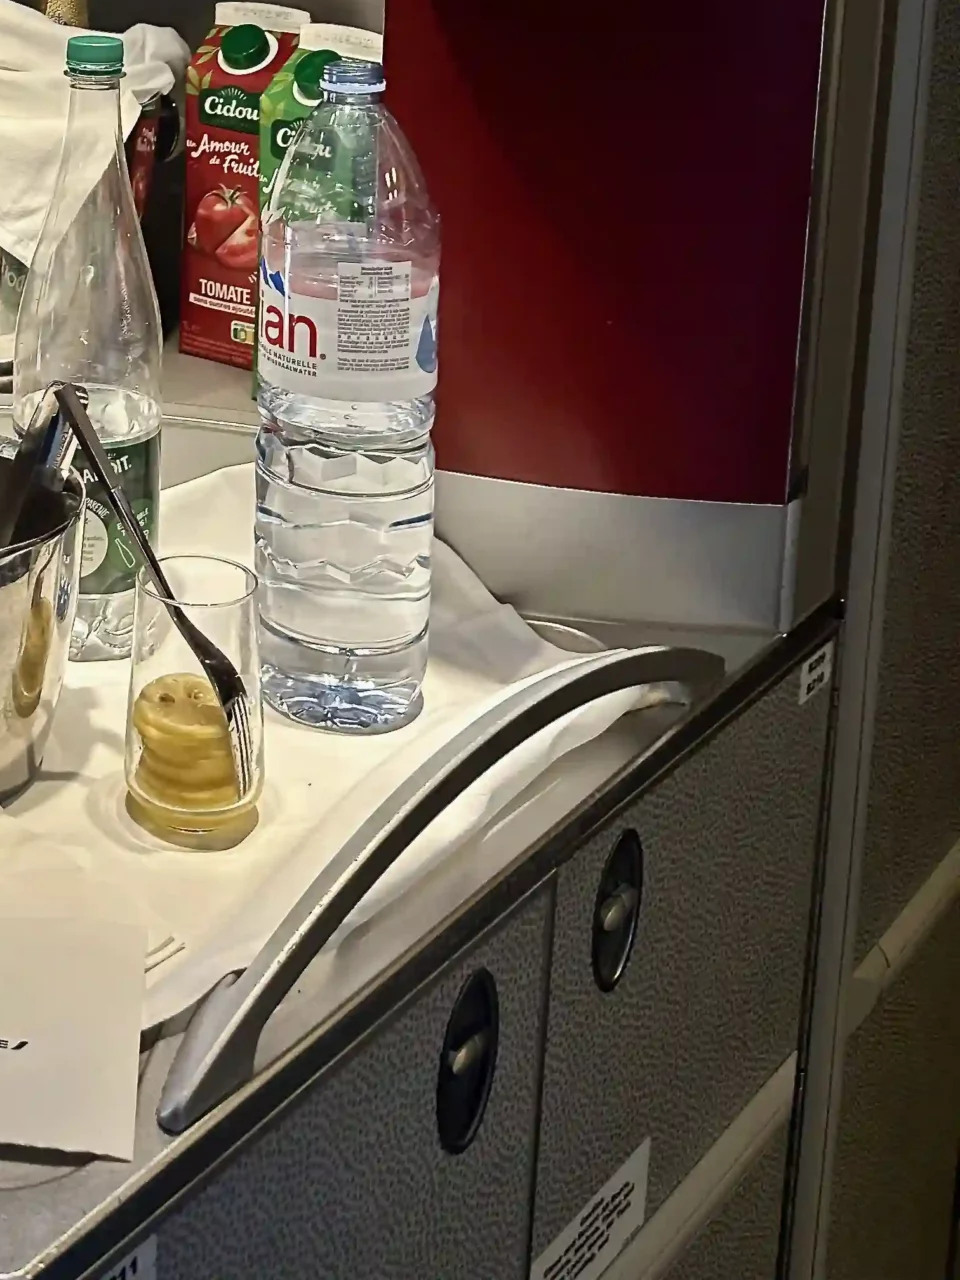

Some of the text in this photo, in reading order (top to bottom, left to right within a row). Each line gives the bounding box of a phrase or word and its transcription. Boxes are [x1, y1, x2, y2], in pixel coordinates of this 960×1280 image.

[203, 95, 261, 121] Cidou
[190, 133, 251, 158] Amour
[209, 154, 261, 178] de Fruit
[199, 278, 252, 305] TOMATE
[273, 351, 318, 371] NATURELLE
